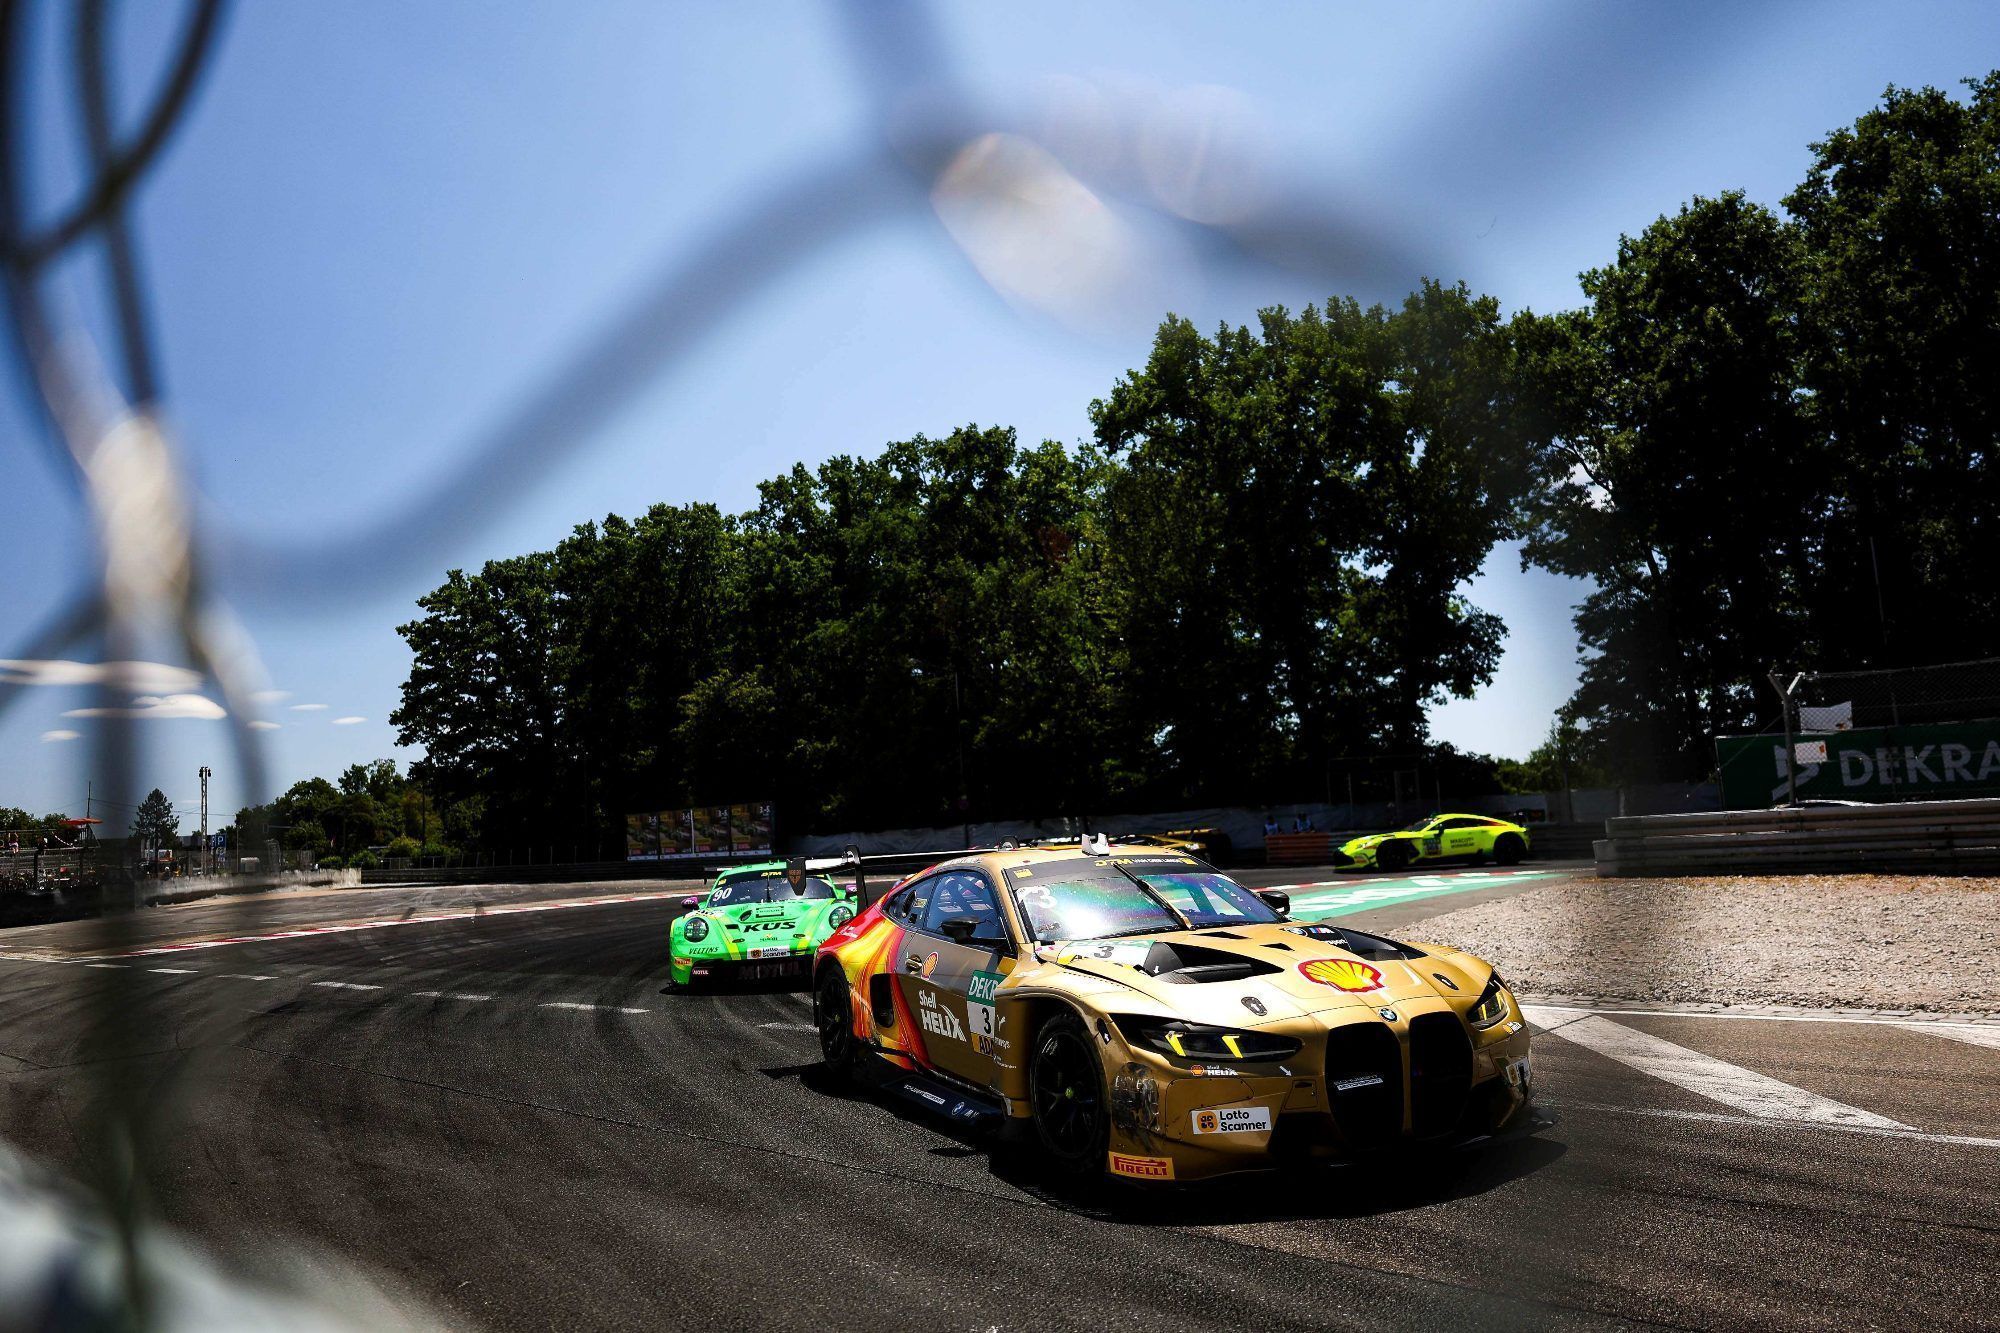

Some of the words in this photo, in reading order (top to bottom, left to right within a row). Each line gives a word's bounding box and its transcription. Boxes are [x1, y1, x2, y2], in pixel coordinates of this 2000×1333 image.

[1839, 739, 2000, 787] DEKRA
[712, 887, 733, 901] 90
[743, 920, 796, 933] KÜS
[689, 946, 720, 955] VELTINS
[1094, 945, 1115, 959] 3
[968, 976, 1000, 1001] DEKR
[918, 990, 936, 1010] Shell
[920, 1008, 967, 1043] HELIX
[981, 1007, 992, 1035] 3
[1207, 1068, 1238, 1076] HELIX
[1219, 1110, 1250, 1121] Lotto
[1220, 1120, 1267, 1133] Scanner
[1113, 1155, 1168, 1177] PIRELLI
